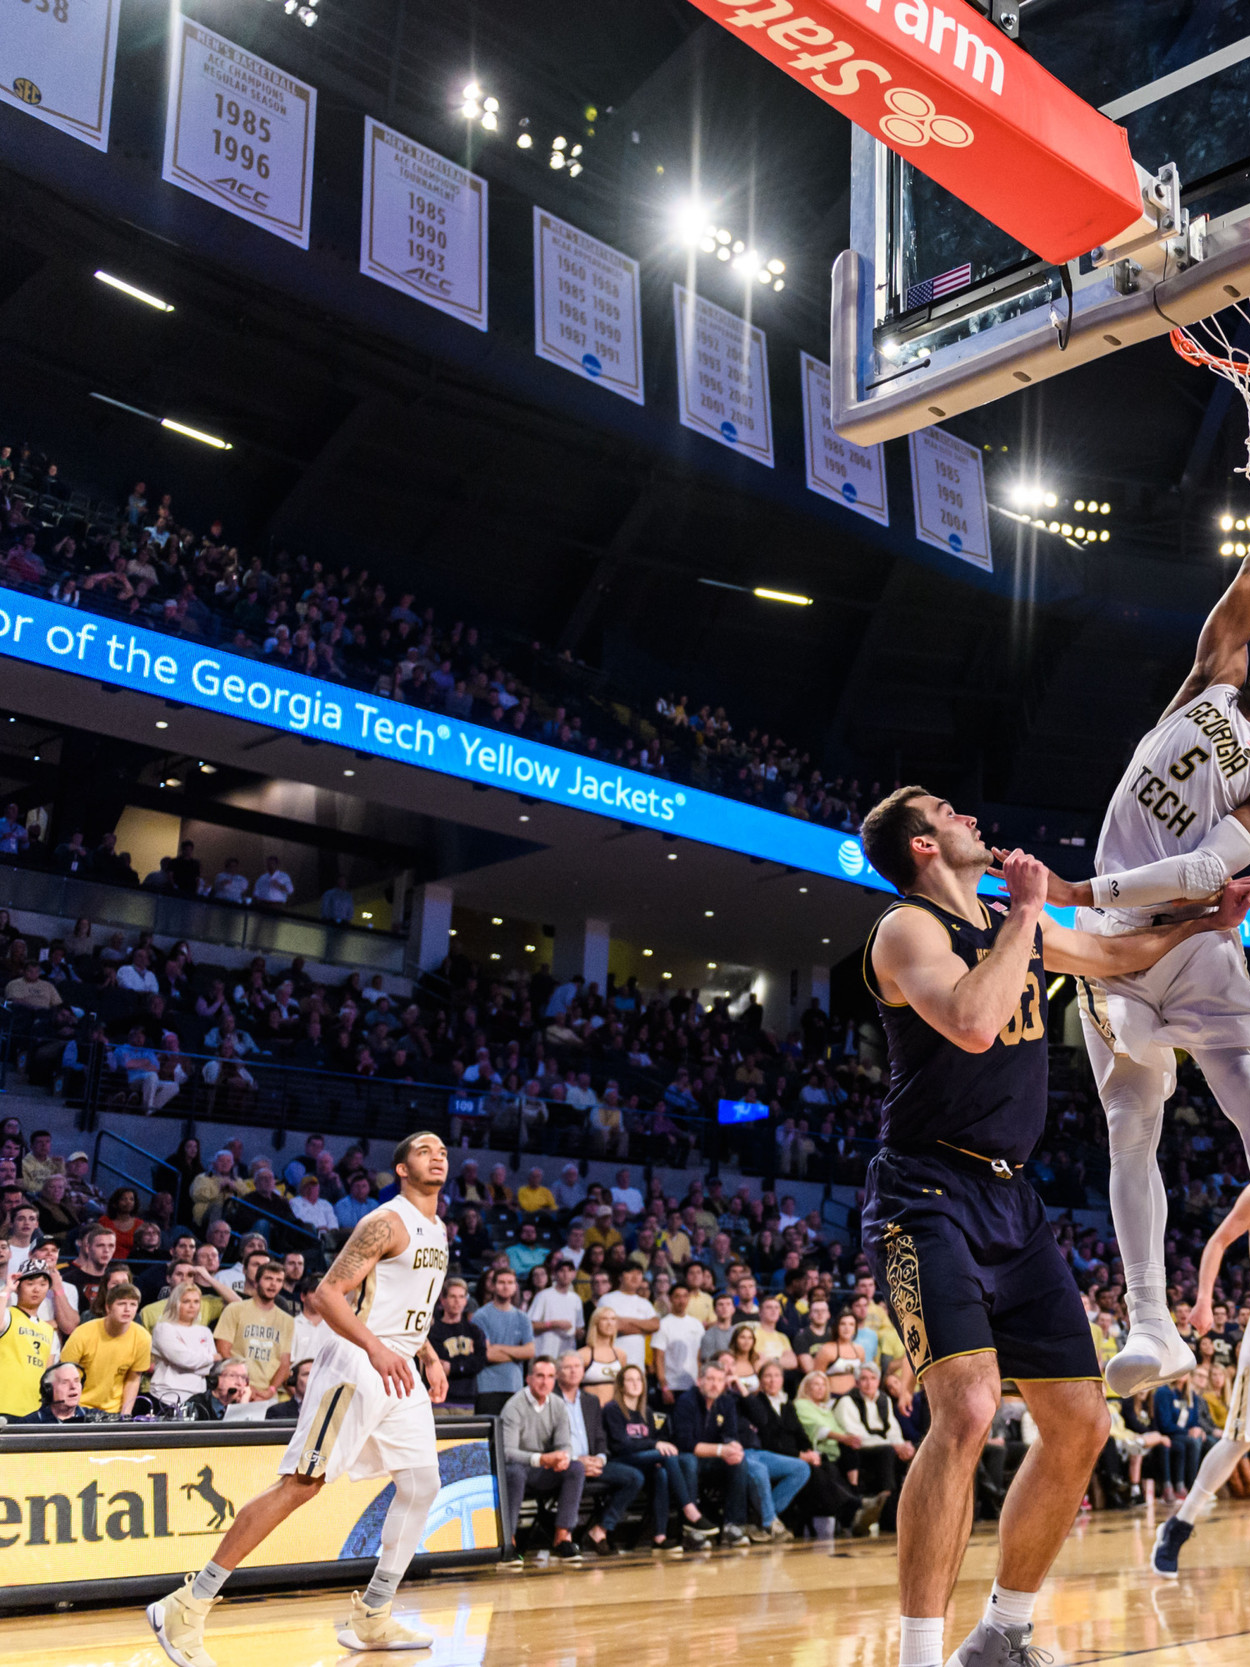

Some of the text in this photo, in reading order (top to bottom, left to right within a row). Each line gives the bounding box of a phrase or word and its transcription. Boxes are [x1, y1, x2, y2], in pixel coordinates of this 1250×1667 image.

[716, 0, 892, 96] Stat
[203, 61, 287, 116] REGULAR SEASON
[207, 52, 285, 103] ACC CHAMPIONS
[215, 93, 271, 143] 1985
[213, 129, 270, 180] 1996
[212, 176, 270, 209] ACC
[400, 167, 456, 203] TOURNAMENT
[411, 159, 461, 195] CHAMPIONS
[408, 191, 446, 225] 1985
[408, 215, 447, 249] 1990
[407, 239, 445, 272] 1993
[558, 254, 586, 281] 1960
[403, 267, 455, 296] ACC
[558, 277, 620, 321] 1985 1989
[559, 299, 622, 343] 1986 1990
[560, 322, 620, 364] 1987 1991
[936, 459, 961, 484] 1985
[938, 484, 963, 509] 1990
[941, 508, 968, 534] 2004
[46, 623, 98, 660] of
[107, 633, 178, 685] the
[191, 659, 343, 731] Georgia
[459, 731, 561, 788] Yellow
[1185, 701, 1248, 780] GEORGIA
[1169, 744, 1210, 783] 5
[1131, 765, 1198, 838] TECH
[426, 1278, 436, 1305] 1
